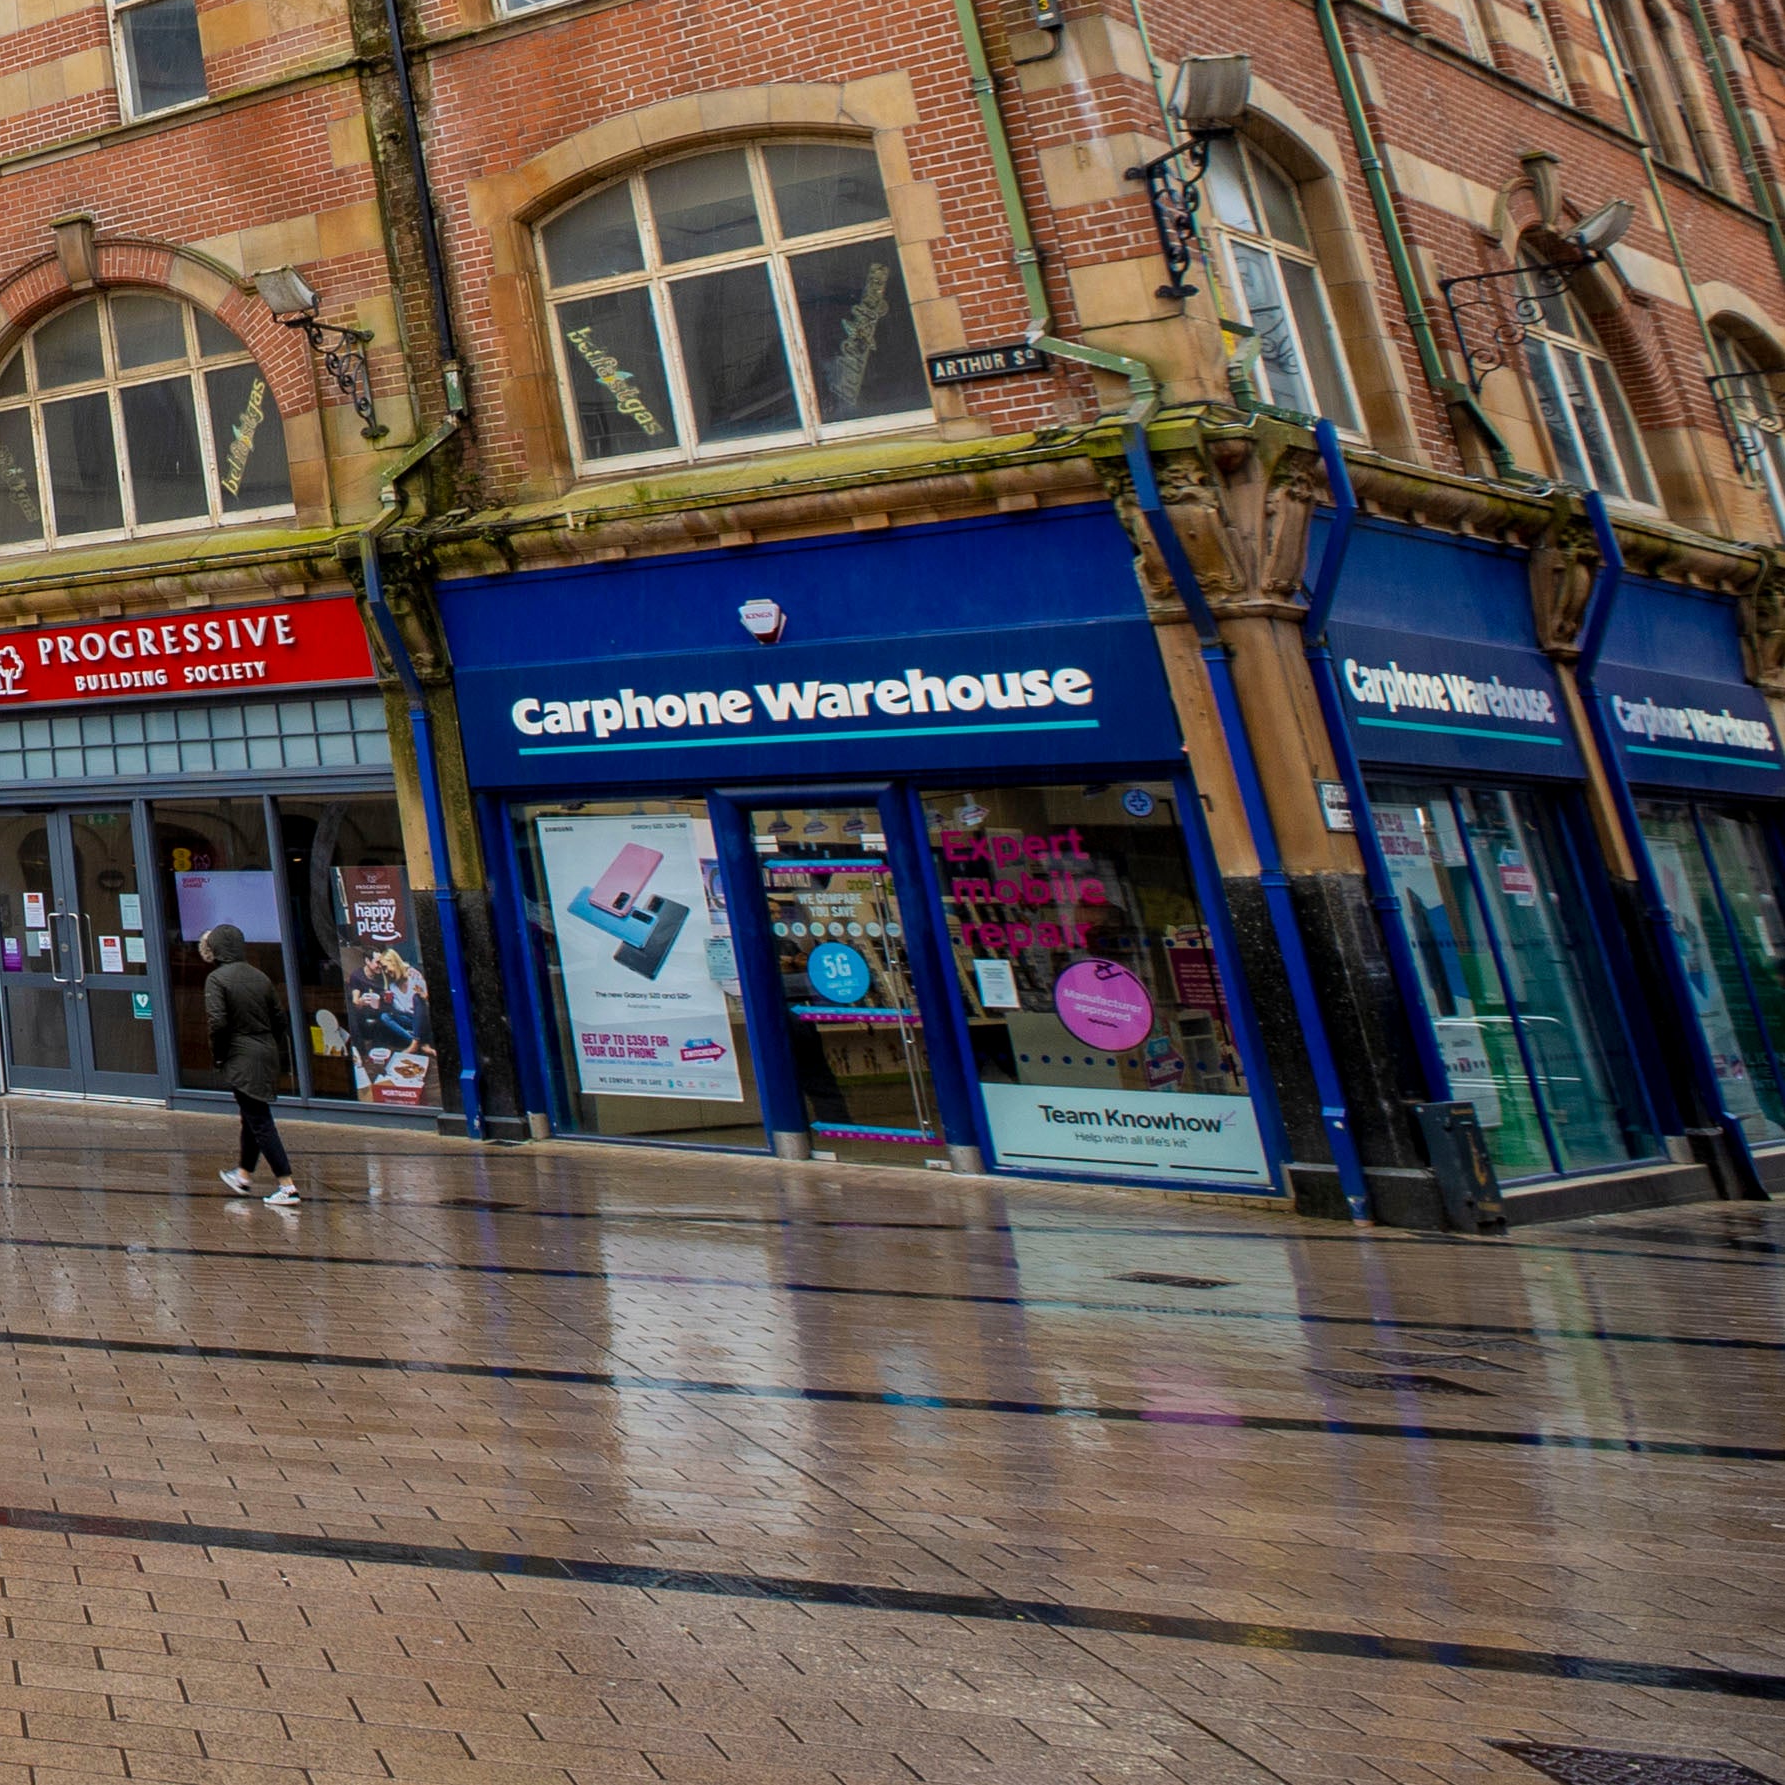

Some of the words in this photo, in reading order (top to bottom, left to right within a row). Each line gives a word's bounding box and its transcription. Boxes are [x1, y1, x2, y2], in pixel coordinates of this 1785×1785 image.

[935, 352, 1006, 378] ARTHUR
[37, 614, 297, 665] PROGRESSIVE
[74, 668, 169, 692] BUILDING
[184, 661, 267, 684] SOCIETY
[512, 688, 753, 738] Carphone
[753, 668, 1094, 721] Warehouse
[1343, 658, 1449, 713] Carphone
[1441, 673, 1556, 724] Warehouse
[1611, 694, 1693, 741] Carphone
[1685, 707, 1775, 751] Warehouse
[941, 827, 1090, 869] Expert
[797, 893, 814, 905] WE
[815, 893, 863, 905] COMPARE
[951, 871, 1107, 906] mobile
[354, 902, 396, 922] happy
[808, 906, 829, 917] YOU
[831, 906, 856, 917] SAVE
[357, 919, 395, 936] place
[961, 913, 1093, 958] repair
[821, 953, 852, 979] 5G
[623, 992, 648, 1000] Galaxy
[1062, 988, 1143, 1013] Manufacturer
[1073, 1003, 1131, 1022] approved
[582, 1033, 597, 1045] GET
[599, 1034, 611, 1045] UP
[613, 1034, 625, 1046] TO
[626, 1035, 649, 1047] £350
[650, 1036, 669, 1047] FOR
[583, 1045, 607, 1057] YOUR
[609, 1046, 626, 1058] OLD
[1037, 1104, 1102, 1126] Team
[1104, 1108, 1221, 1133] Knowhow
[1074, 1131, 1101, 1143] Help
[1103, 1133, 1129, 1145] with
[1131, 1135, 1143, 1145] all
[1145, 1136, 1171, 1148] life's
[1173, 1137, 1188, 1148] kit
